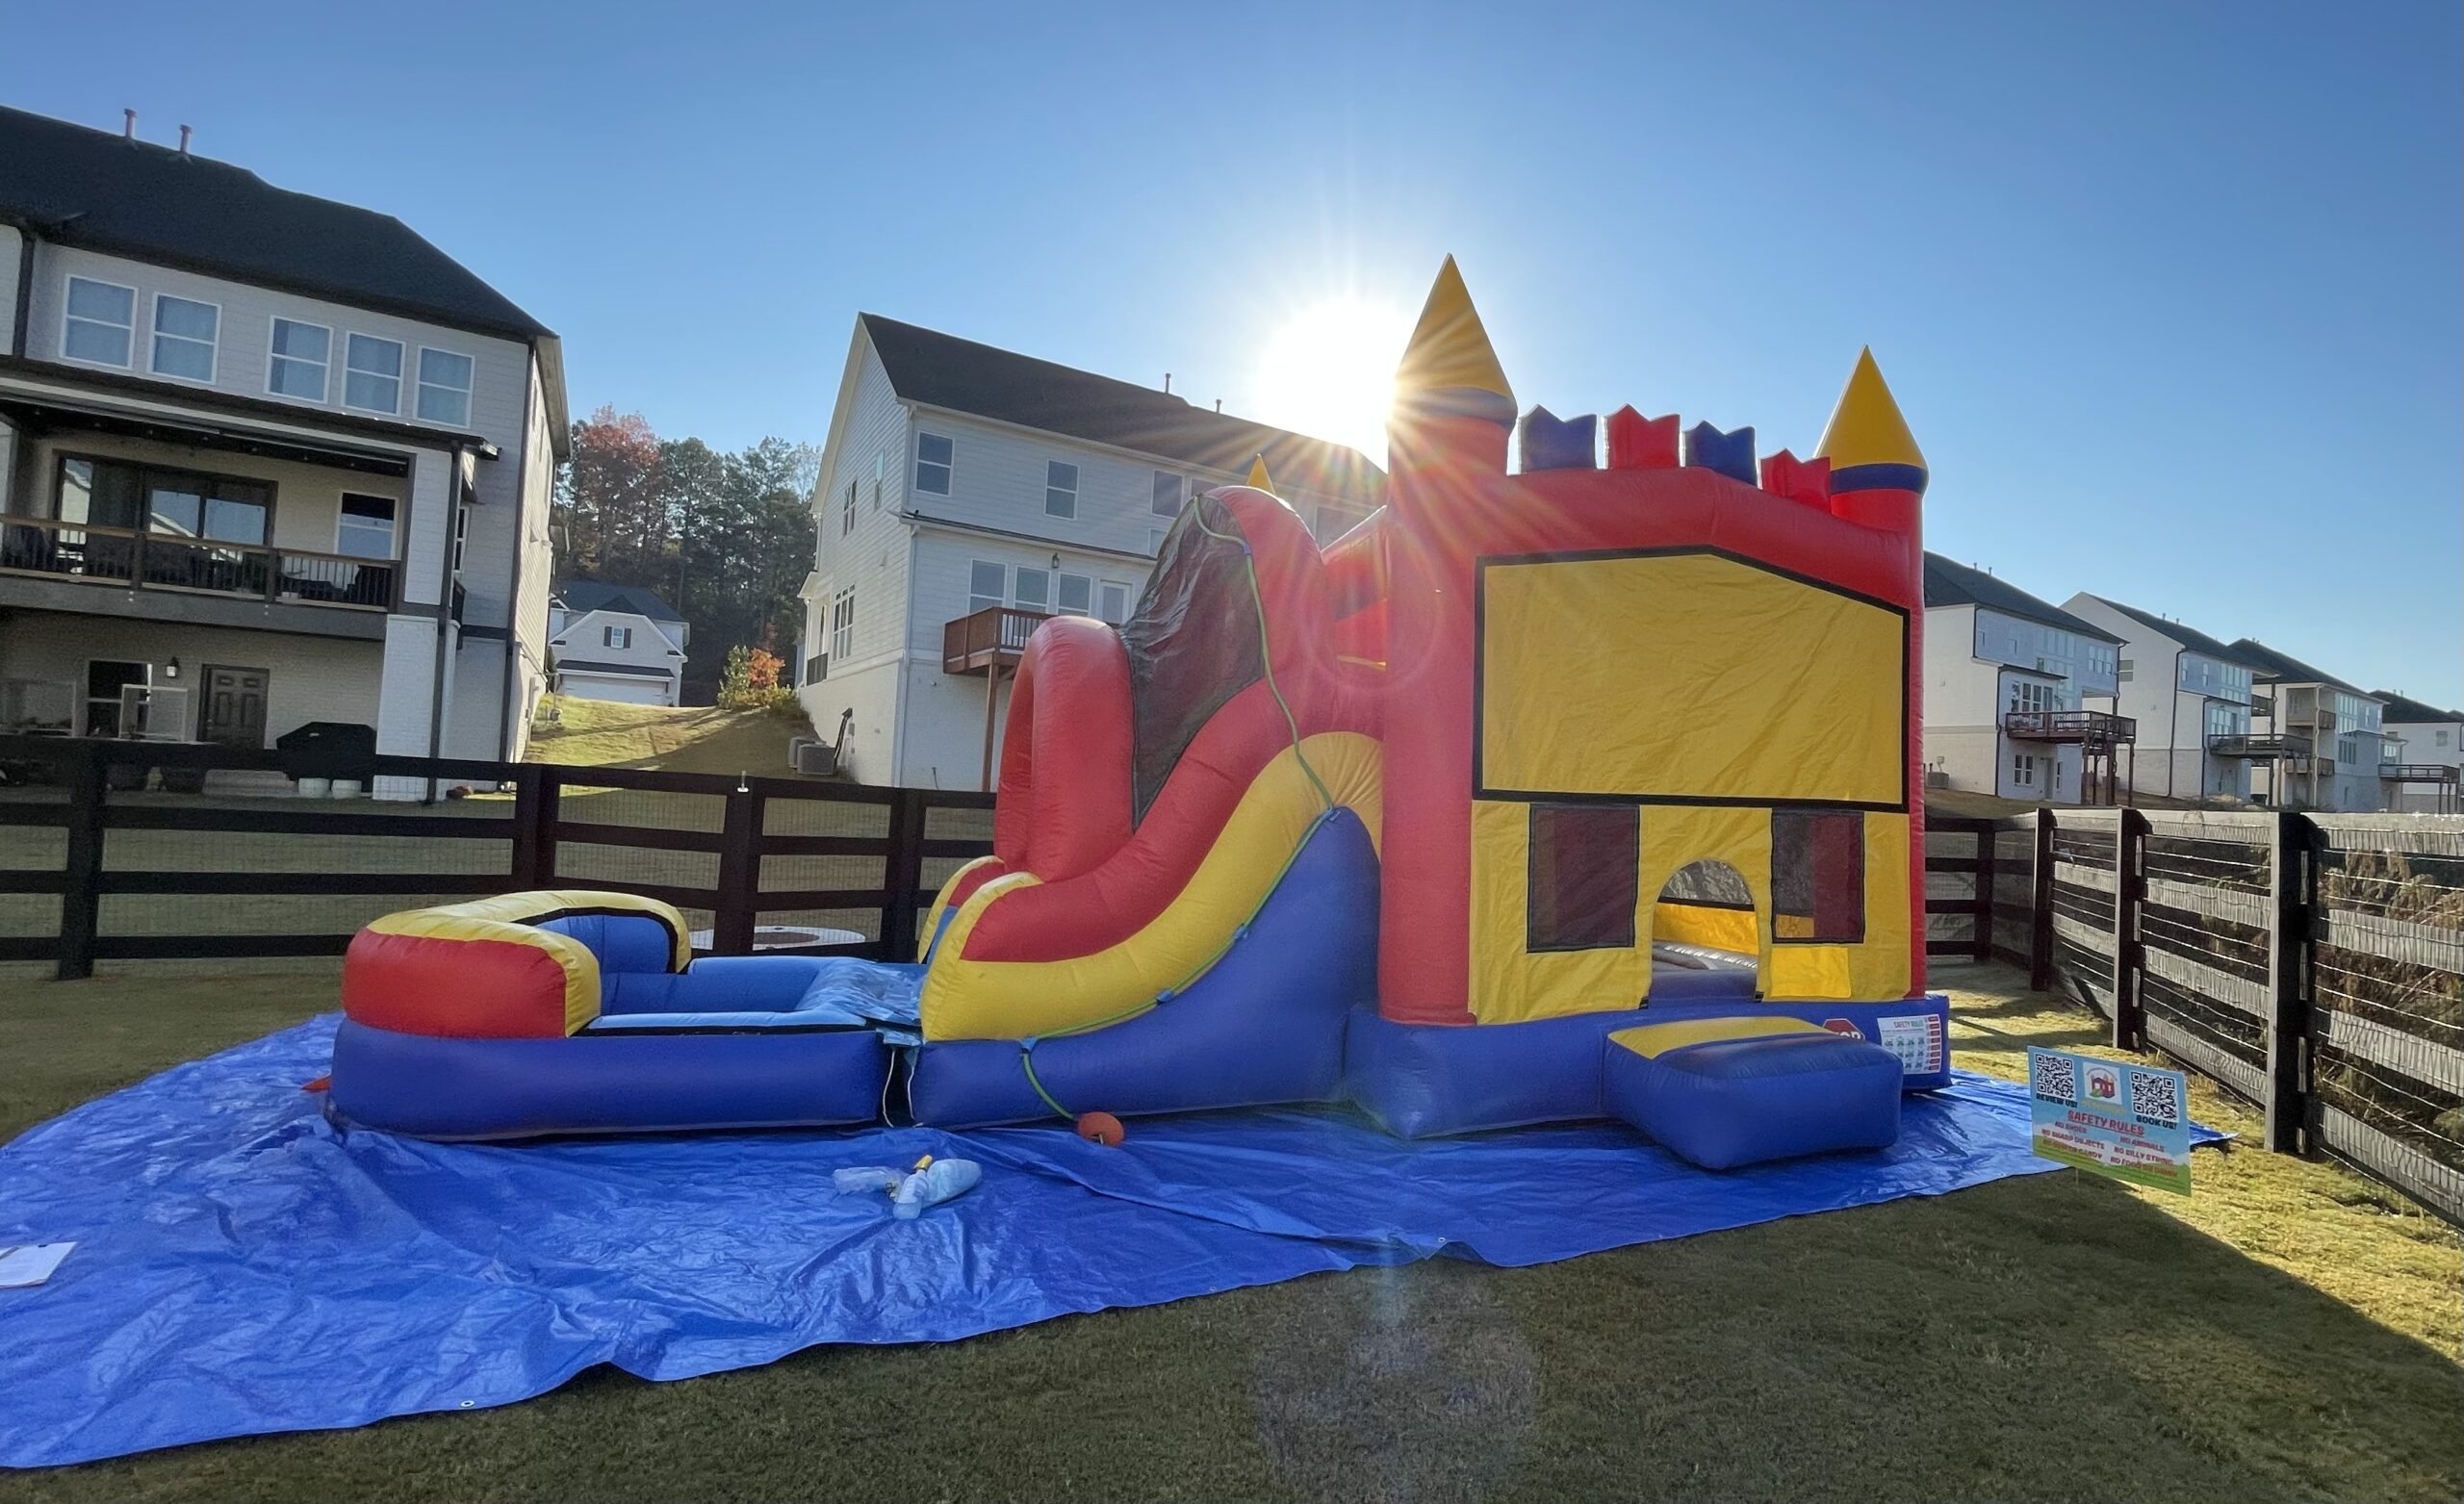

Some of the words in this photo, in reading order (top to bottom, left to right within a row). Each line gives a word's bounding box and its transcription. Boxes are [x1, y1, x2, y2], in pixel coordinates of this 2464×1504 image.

[2036, 1093, 2064, 1105] REVIEW
[2067, 1109, 2107, 1127] SAFETY
[2109, 1119, 2144, 1136] RULES
[2136, 1115, 2161, 1126] BOOK
